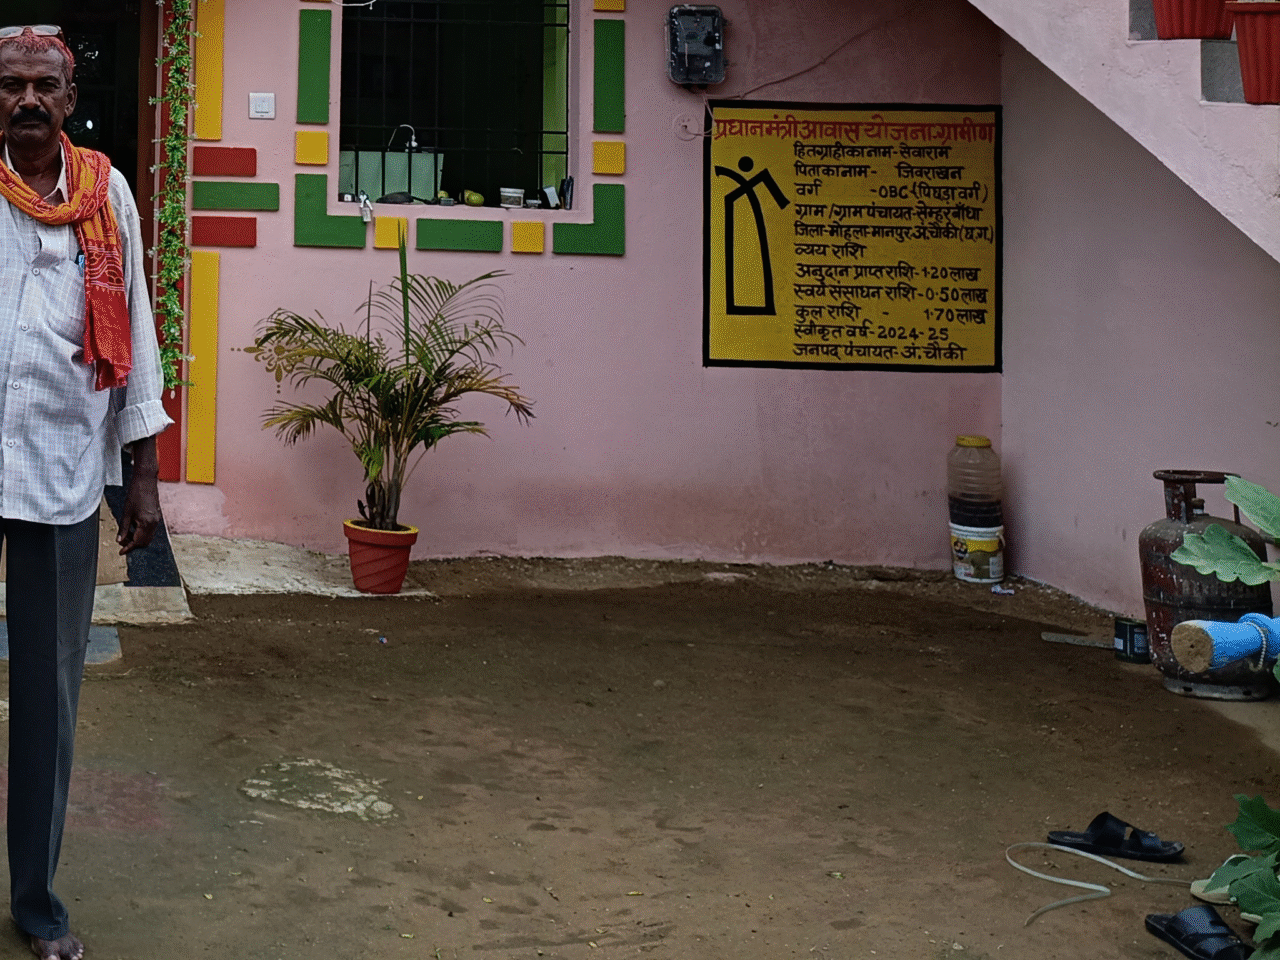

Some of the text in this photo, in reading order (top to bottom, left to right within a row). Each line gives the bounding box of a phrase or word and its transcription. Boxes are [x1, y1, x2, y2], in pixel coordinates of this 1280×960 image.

[794, 178, 822, 196] वर्ग
[794, 203, 827, 220] ग्राम
[794, 242, 867, 259] व्यय राशि
[795, 263, 852, 281] अनुदान
[829, 280, 883, 300] संसाधन
[794, 304, 826, 323] कुल
[827, 301, 861, 319] राशि
